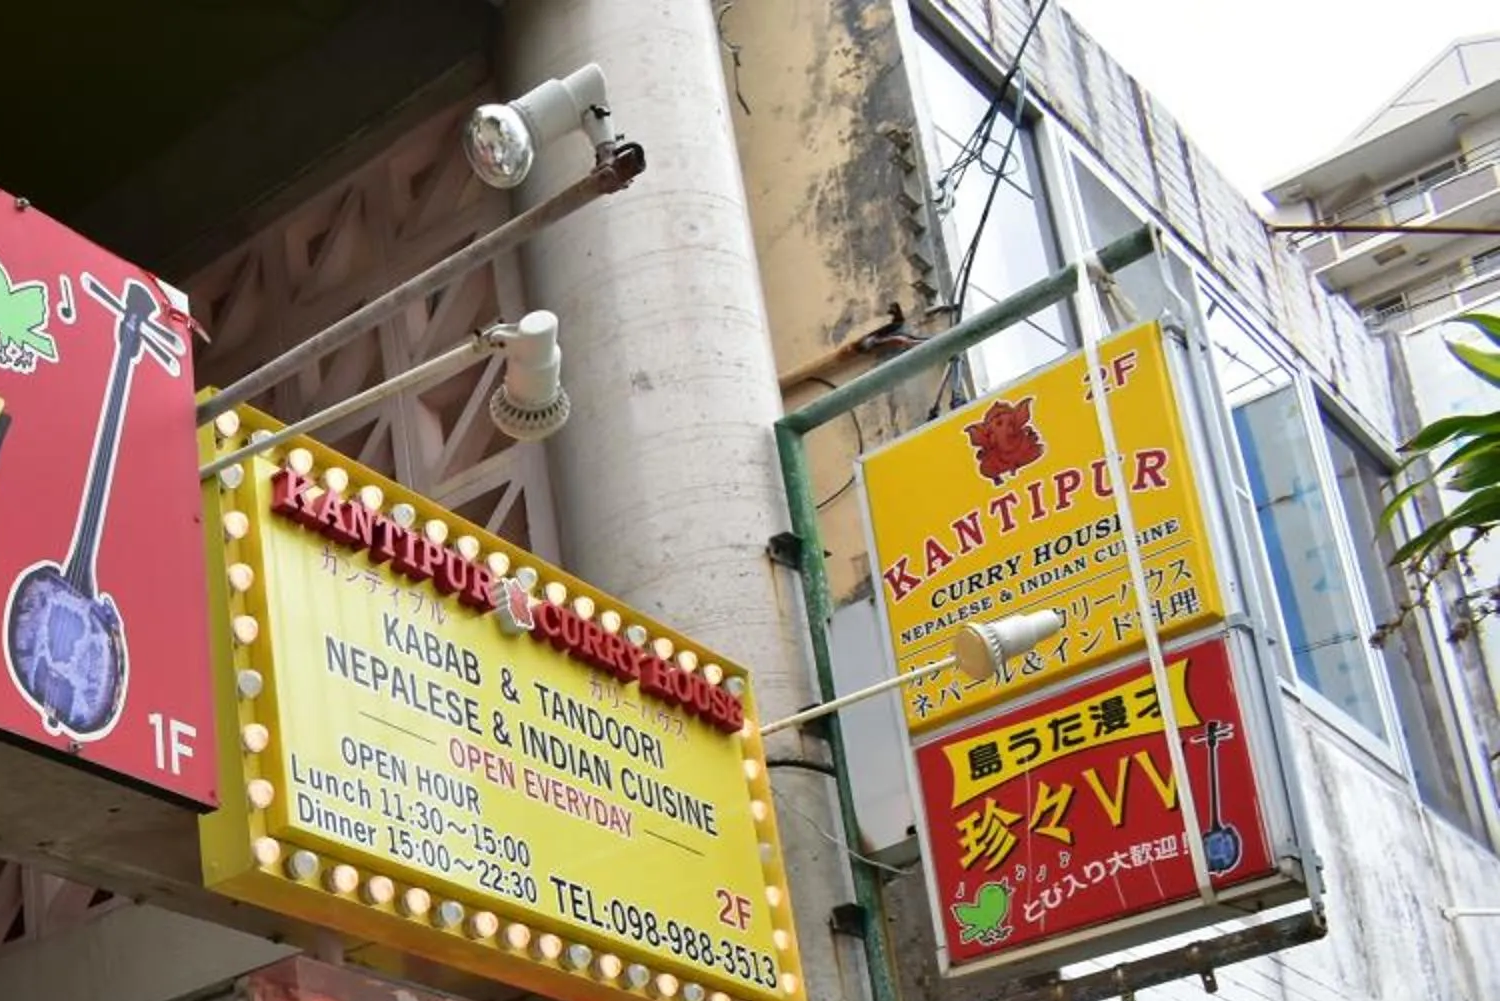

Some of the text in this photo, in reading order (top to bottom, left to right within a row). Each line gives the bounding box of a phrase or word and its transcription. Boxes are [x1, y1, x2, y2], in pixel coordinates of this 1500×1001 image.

[883, 449, 1168, 602] KANTIPUR
[277, 468, 745, 731] KANTIPUR CURRY HOUSE
[900, 594, 994, 646] NEPALESE
[999, 588, 1014, 604] &
[1018, 556, 1088, 596] INDIAN
[930, 554, 1023, 610] CURRY
[325, 636, 719, 837] NEPALESE & INDIAN CUISINE
[383, 611, 665, 769] KABAB & TANDOORI
[966, 683, 1164, 782] 島うた漫才
[148, 712, 198, 776] 1F
[291, 752, 372, 809] Lunch
[341, 735, 482, 816] OPEN HOUR
[449, 736, 633, 838] OPEN EVERYDAY
[297, 791, 377, 847] Dinner
[550, 875, 778, 989] TEL:098-988-3513
[715, 889, 752, 930] 2F
